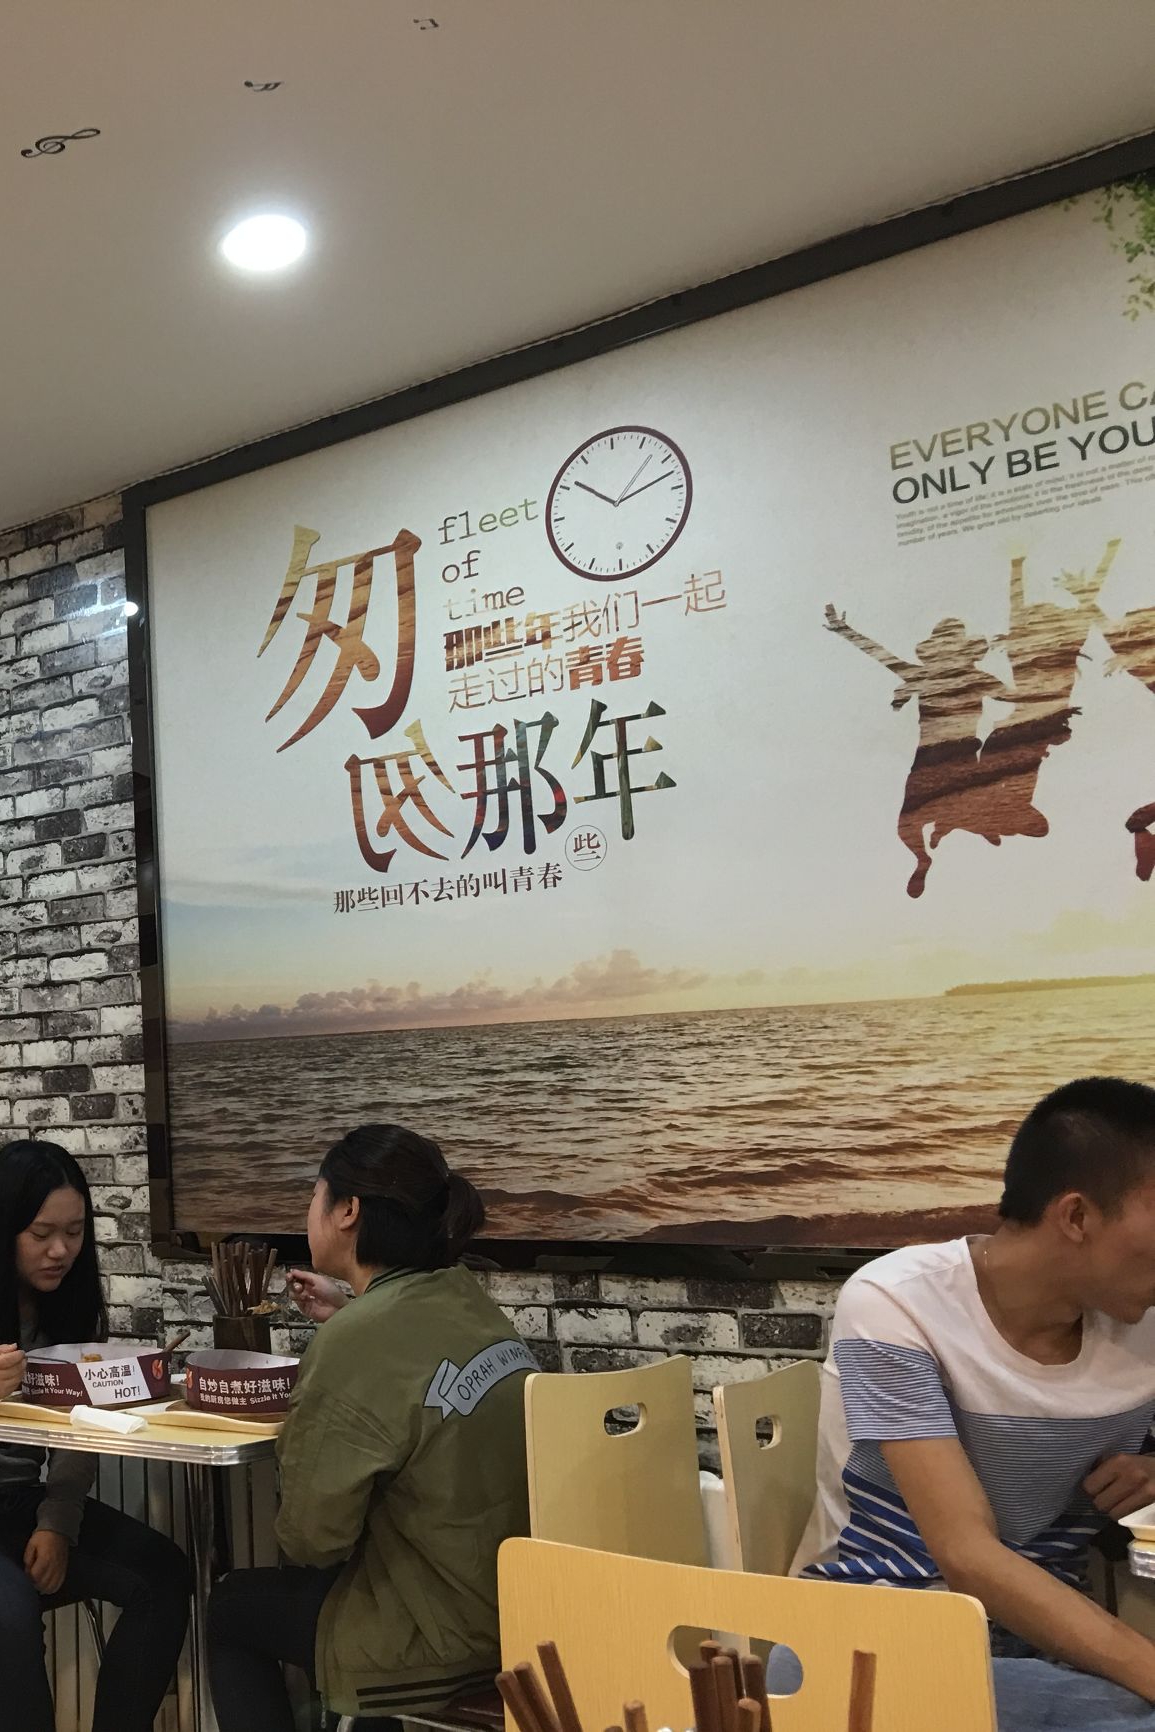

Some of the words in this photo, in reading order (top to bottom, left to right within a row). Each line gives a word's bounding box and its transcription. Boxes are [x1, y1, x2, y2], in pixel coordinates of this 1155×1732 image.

[889, 390, 1109, 471] EVERYONE
[1118, 381, 1155, 411] C
[892, 456, 995, 504] ONLY
[1006, 440, 1060, 478] BE
[438, 498, 538, 545] fleet
[442, 550, 481, 583] of
[443, 586, 525, 620] time
[443, 569, 727, 671] 那些年我们一起
[449, 636, 645, 713] 走过的青春
[572, 832, 602, 862] 些
[333, 862, 563, 914] 那些回不去的叫青春
[84, 1364, 136, 1381] 小心高温!
[92, 1379, 124, 1388] CAUTION
[199, 1377, 291, 1394] 自炒自煮好滋味!
[457, 1357, 498, 1400] OPRAH
[50, 1387, 64, 1395] Your
[65, 1388, 83, 1397] Way!
[114, 1386, 141, 1399] HOT!
[249, 1394, 270, 1405] Sizzle
